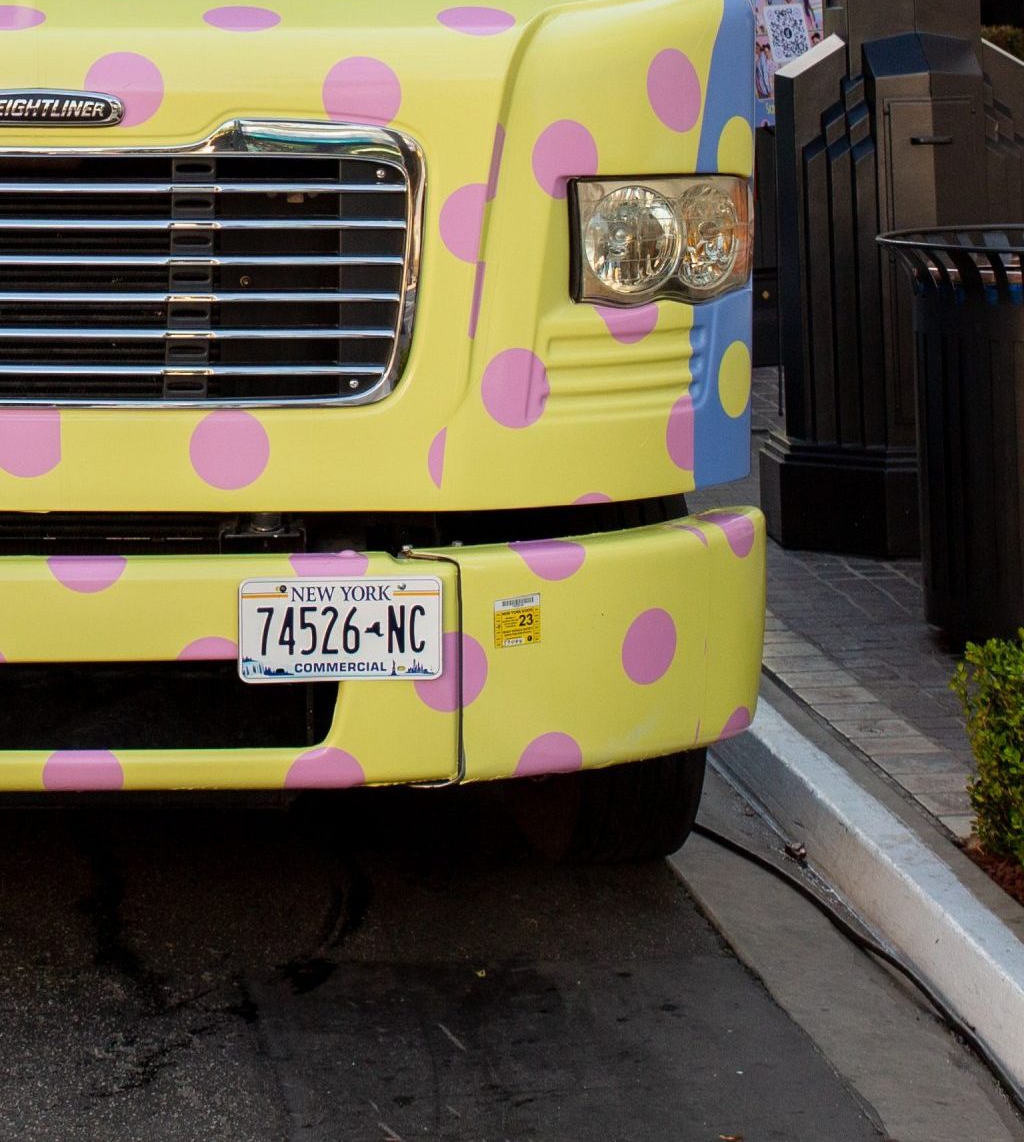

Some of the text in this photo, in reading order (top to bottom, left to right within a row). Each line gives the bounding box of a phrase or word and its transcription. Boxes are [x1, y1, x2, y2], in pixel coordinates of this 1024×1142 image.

[291, 585, 392, 602] NEW YORK
[519, 613, 534, 627] 23
[294, 662, 387, 673] COMMERCIAL
